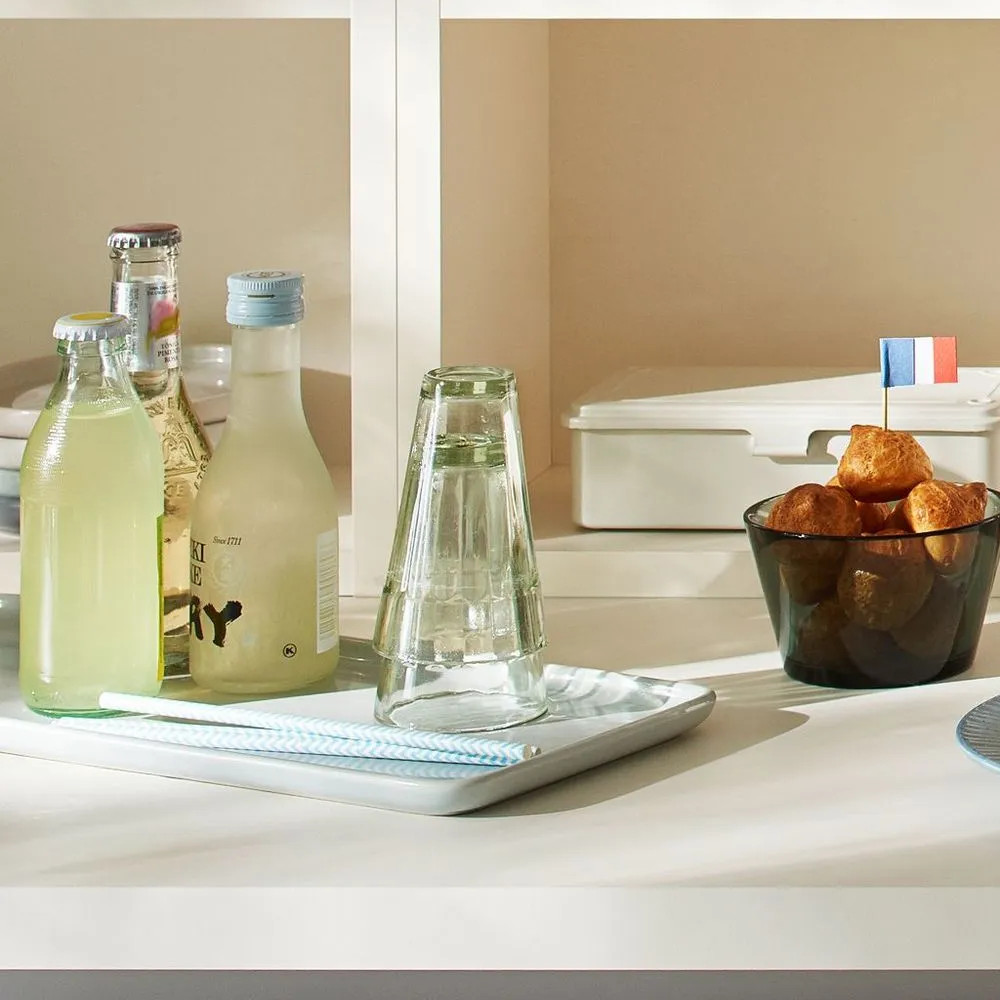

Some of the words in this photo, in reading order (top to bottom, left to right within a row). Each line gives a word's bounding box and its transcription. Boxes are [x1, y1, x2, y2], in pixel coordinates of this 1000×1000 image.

[190, 538, 208, 564] KI
[226, 536, 242, 546] 1711
[190, 595, 242, 648] RY
